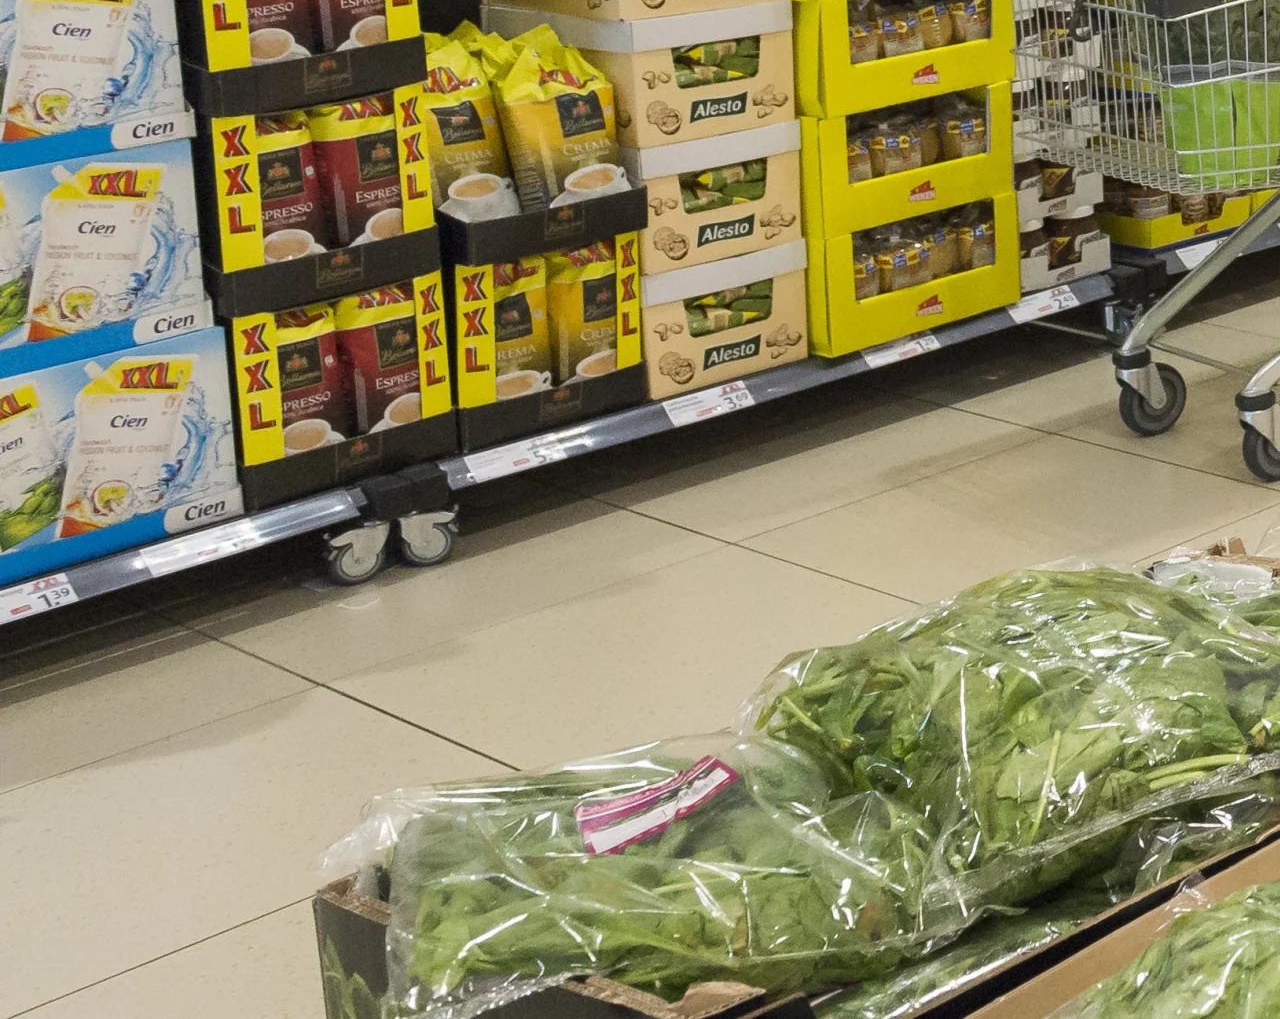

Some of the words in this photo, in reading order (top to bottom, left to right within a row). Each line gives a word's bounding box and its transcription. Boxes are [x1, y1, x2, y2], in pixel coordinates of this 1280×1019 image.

[249, 2, 295, 17] PRESSO
[52, 22, 93, 39] Cien
[693, 99, 743, 119] Alesto
[131, 120, 175, 140] Cien
[87, 169, 147, 198] XXL
[77, 220, 117, 235] Cien
[702, 220, 751, 241] Alesto
[153, 313, 195, 334] Cien
[707, 341, 757, 365] Alesto
[119, 362, 179, 390] XXL
[283, 391, 331, 412] PRESSO
[726, 392, 749, 410] 3.69
[110, 414, 148, 429] Cien
[184, 500, 227, 522] Cien
[37, 587, 71, 609] 1.39
